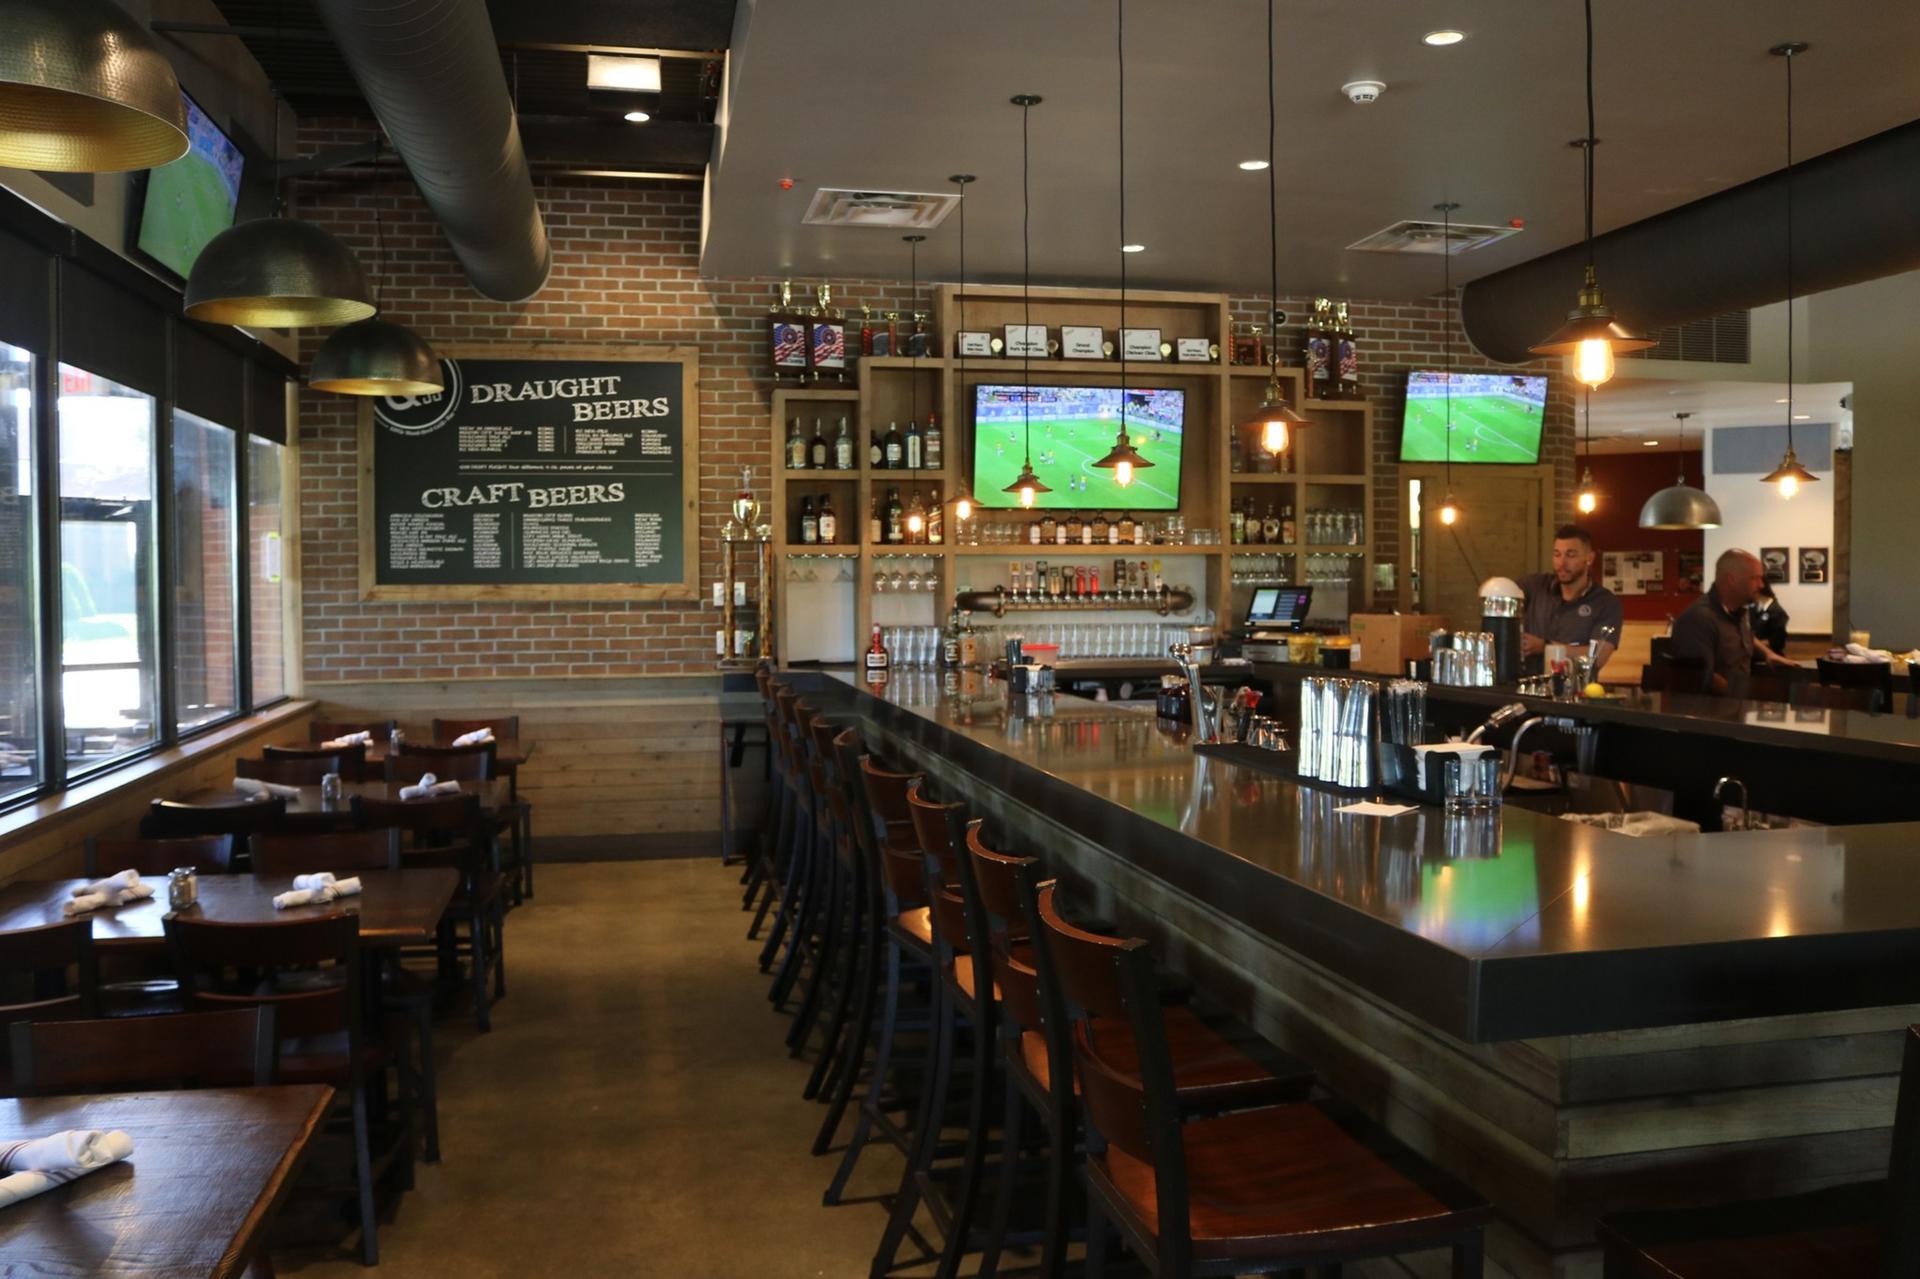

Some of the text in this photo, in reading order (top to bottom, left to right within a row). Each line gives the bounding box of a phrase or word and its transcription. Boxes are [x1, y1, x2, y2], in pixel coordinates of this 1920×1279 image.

[470, 376, 621, 403] DRAUGHT
[572, 397, 670, 422] BEERS
[421, 482, 625, 508] CRAFT BEERS
